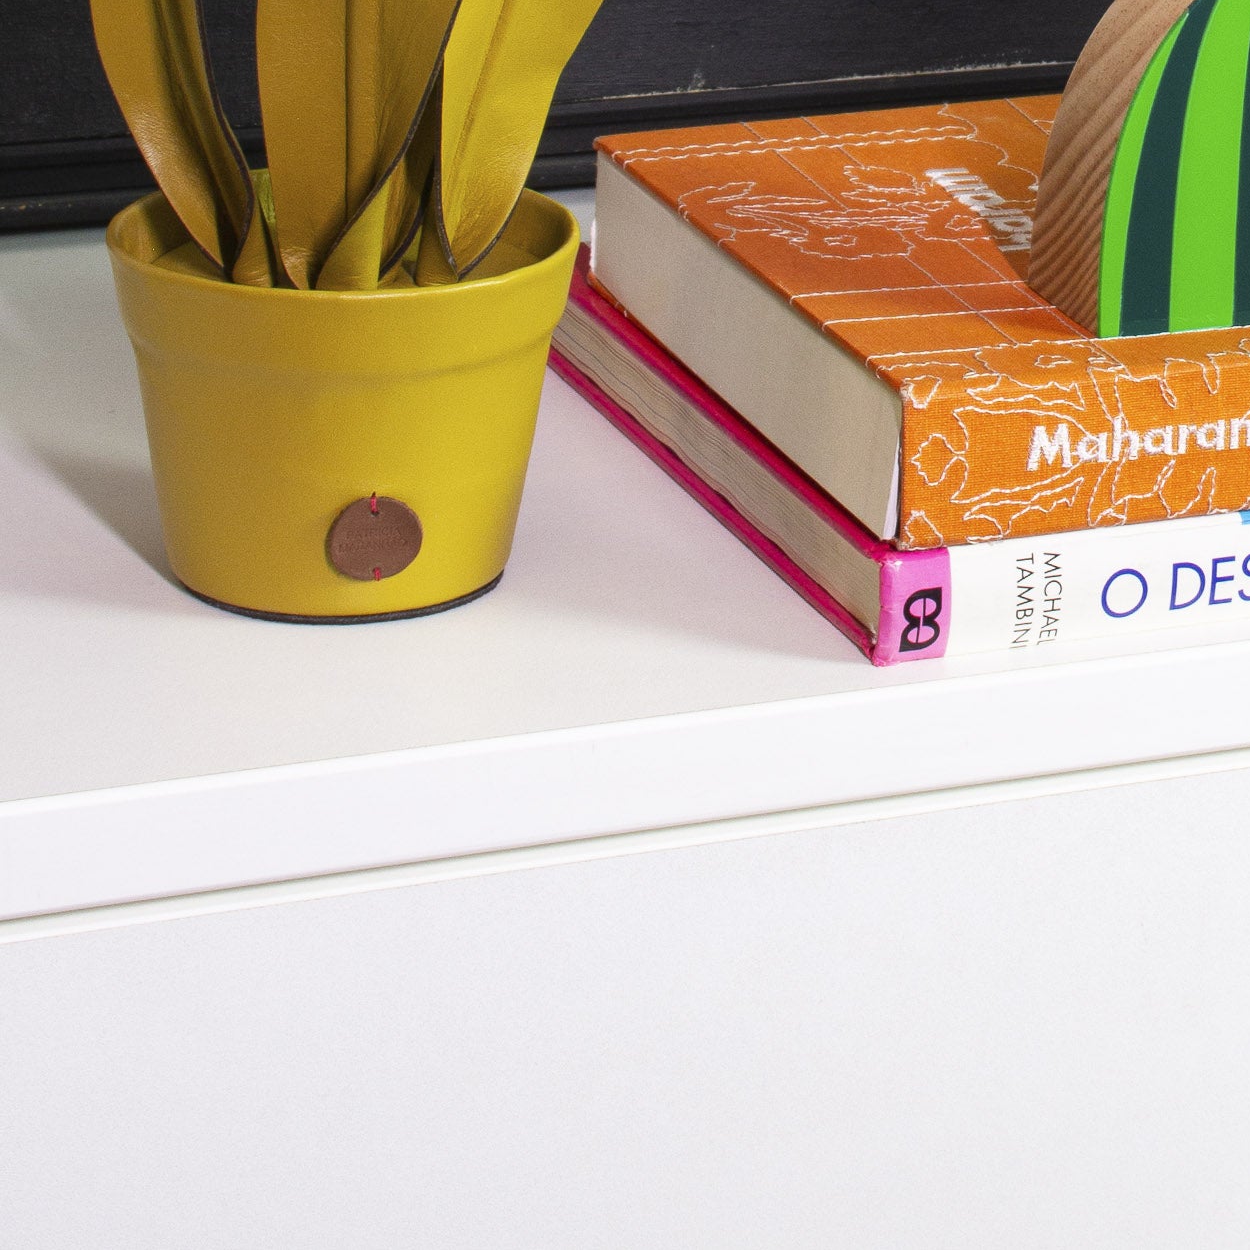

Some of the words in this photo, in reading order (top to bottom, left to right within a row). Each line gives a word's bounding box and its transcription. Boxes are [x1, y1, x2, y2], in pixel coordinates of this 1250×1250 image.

[922, 167, 1034, 252] haram
[1009, 552, 1035, 649] TAMBINI
[1036, 552, 1063, 646] MICHAEL
[1101, 568, 1148, 618] O
